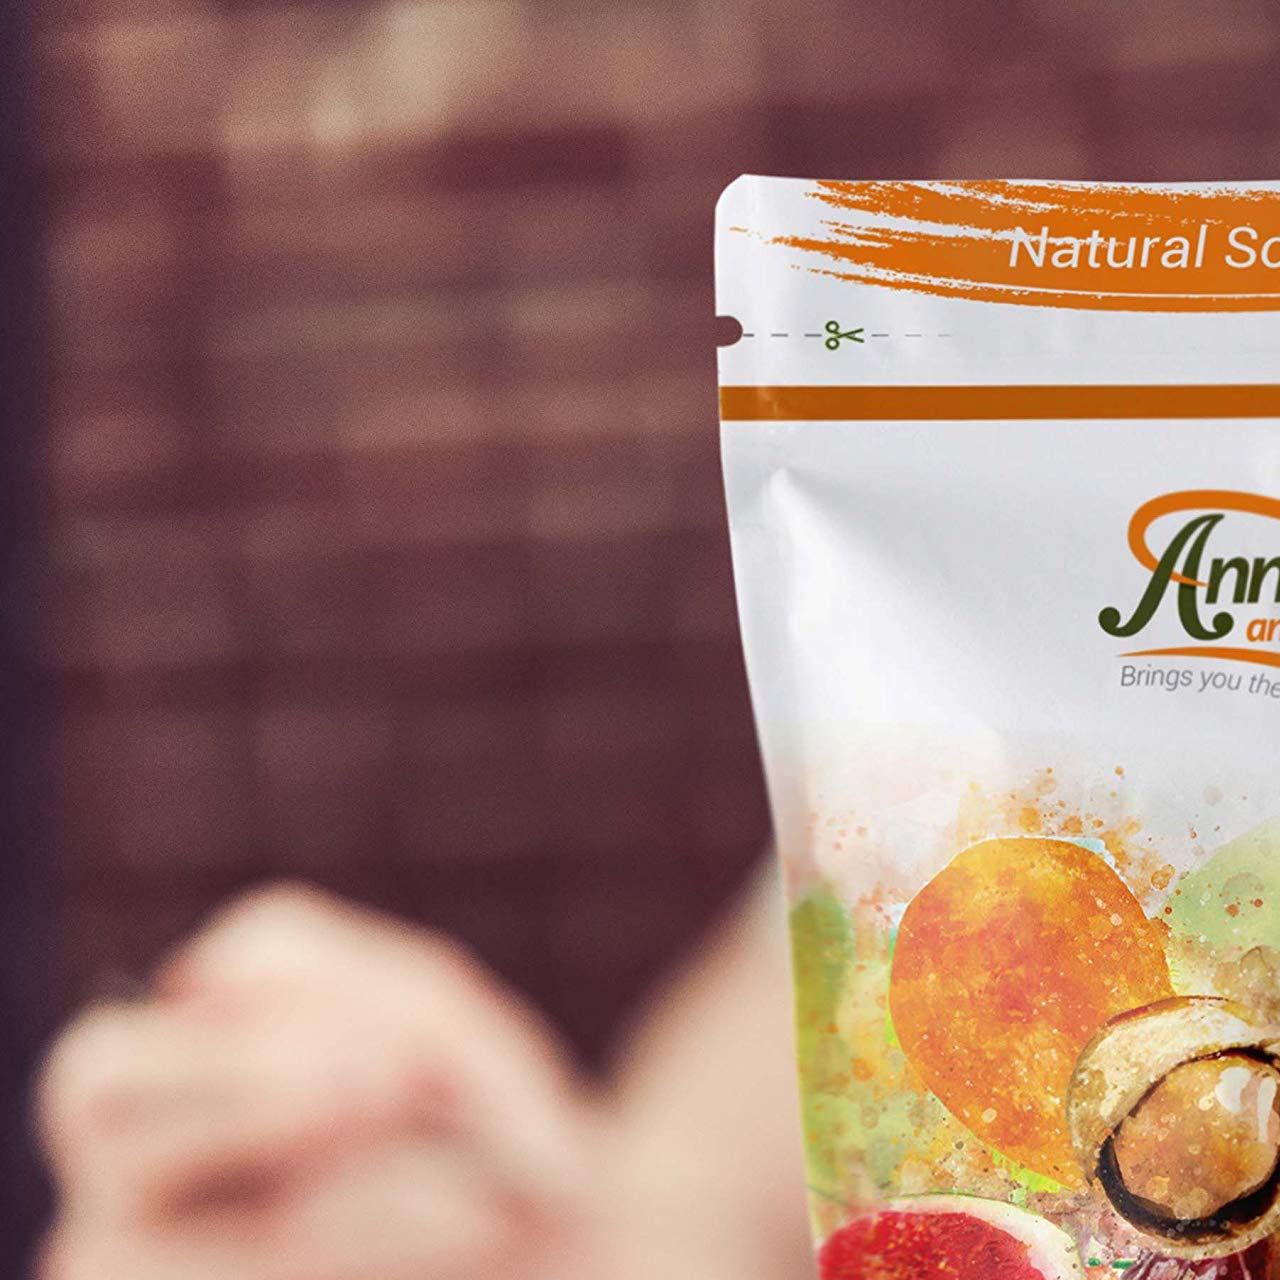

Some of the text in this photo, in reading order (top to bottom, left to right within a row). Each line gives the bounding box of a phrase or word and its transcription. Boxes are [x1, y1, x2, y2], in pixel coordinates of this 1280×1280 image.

[1009, 224, 1207, 269] Natural
[1120, 664, 1193, 691] Brings
[1199, 668, 1241, 692] you
